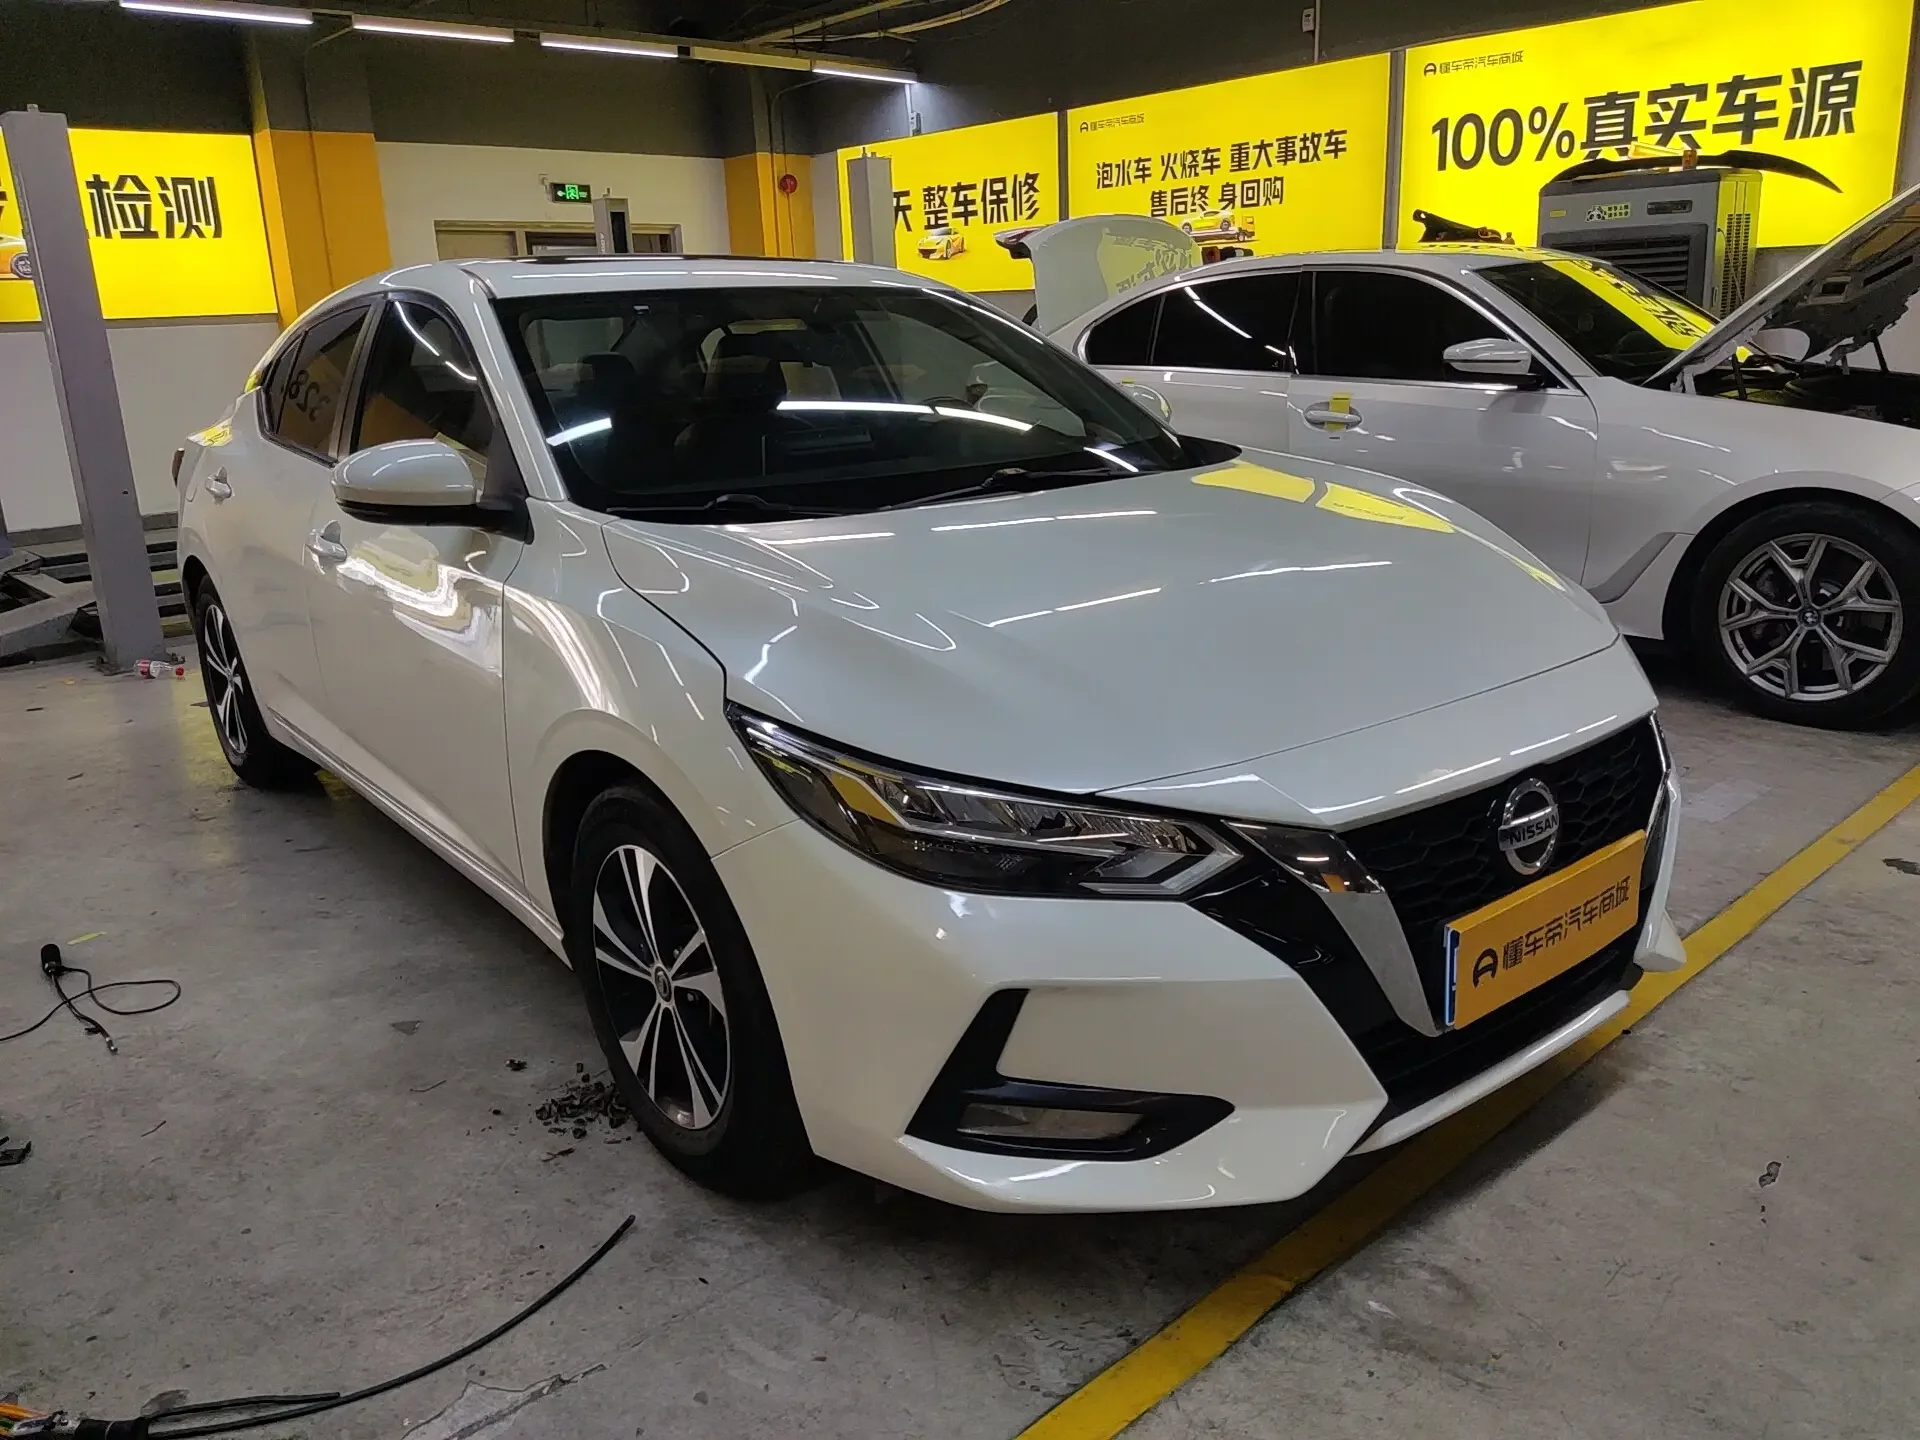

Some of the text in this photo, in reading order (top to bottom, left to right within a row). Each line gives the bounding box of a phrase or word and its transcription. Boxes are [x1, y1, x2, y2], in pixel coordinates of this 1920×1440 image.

[1431, 60, 1863, 171] 100%真实车源
[1096, 129, 1348, 189] 泡水车 火烧车 重大事故车
[85, 174, 223, 239] 检测
[922, 172, 1041, 231] 整车保修
[1149, 176, 1285, 217] 售后终 身回购
[1508, 815, 1558, 845] NISSAN
